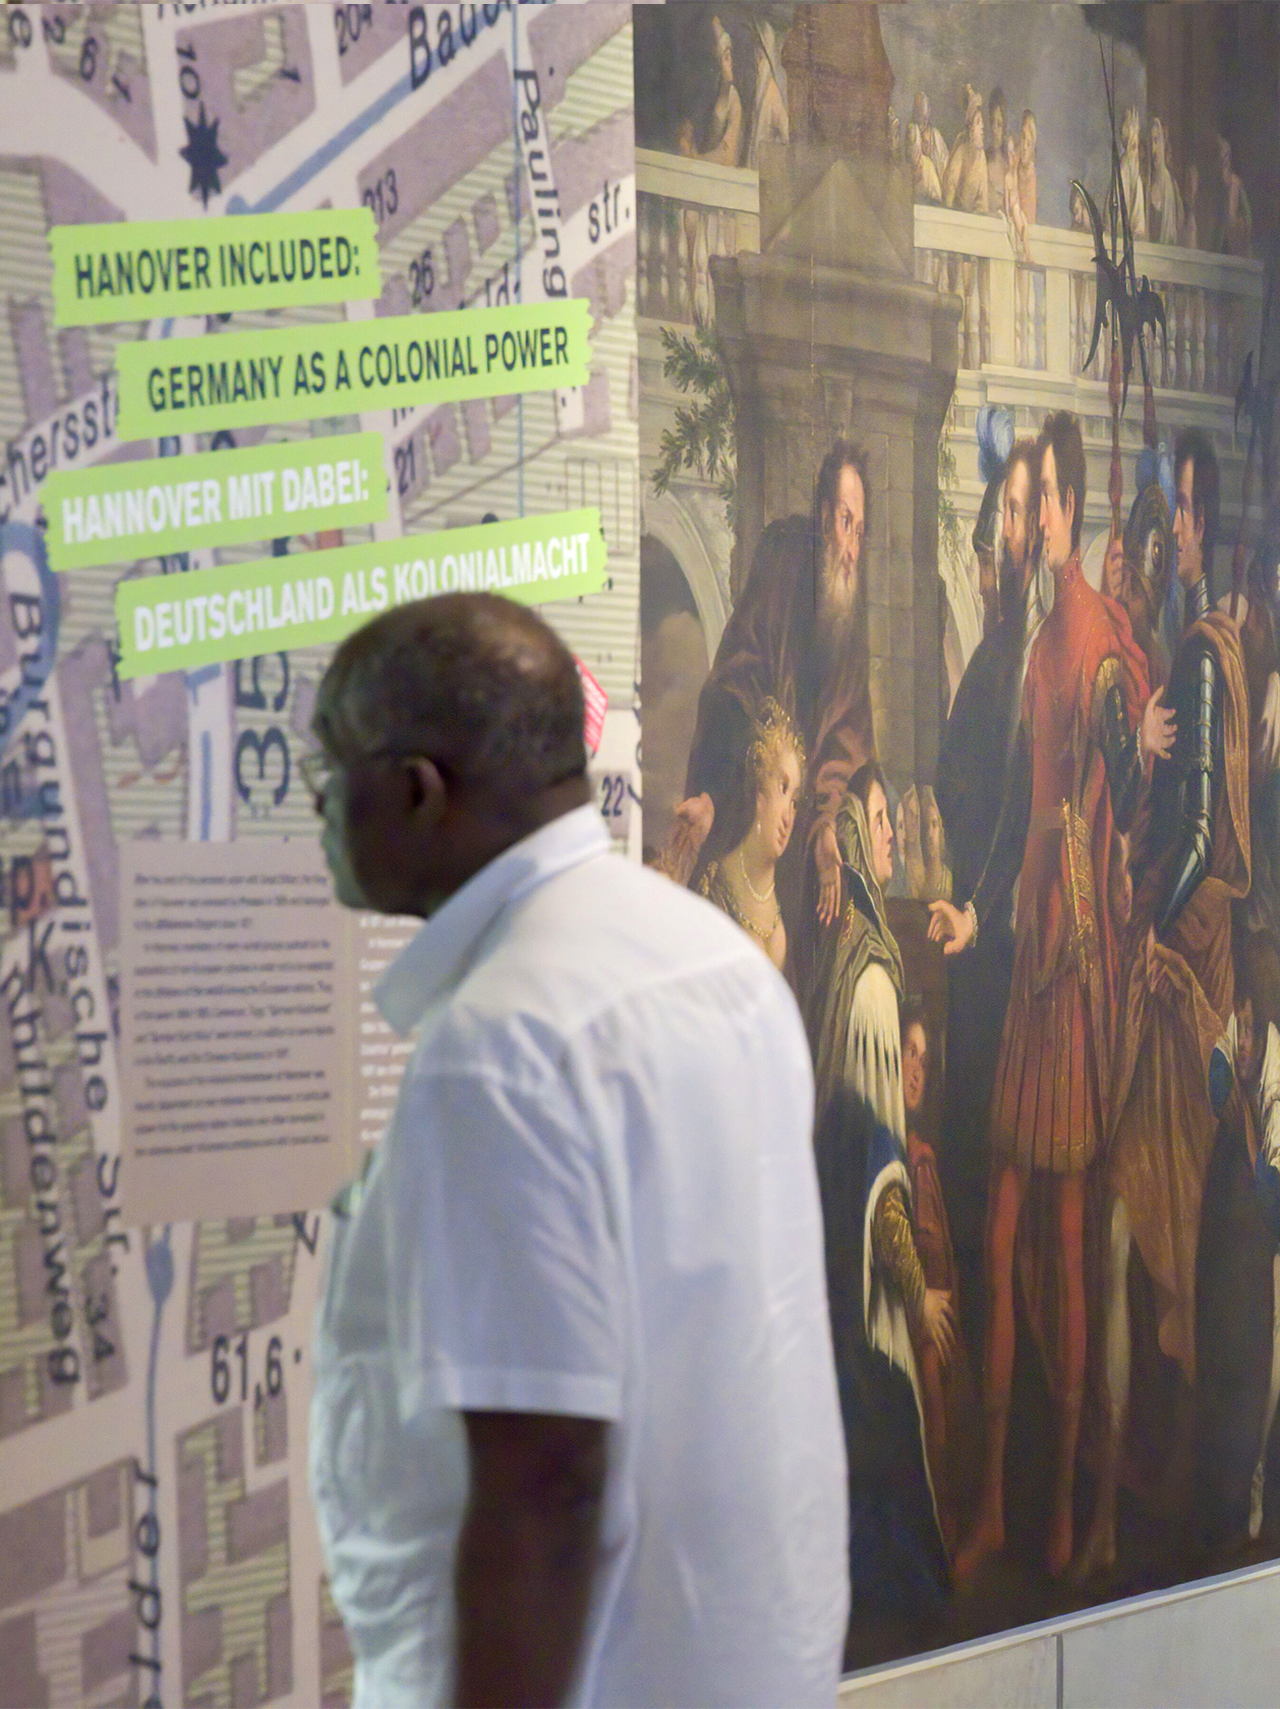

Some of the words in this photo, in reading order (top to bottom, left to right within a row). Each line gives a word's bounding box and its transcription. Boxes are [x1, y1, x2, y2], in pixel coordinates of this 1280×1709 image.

[74, 245, 210, 300] HANOVER
[219, 236, 361, 289] INCLUDED:
[147, 355, 284, 413] GERMANY
[293, 351, 327, 397] AS
[335, 349, 353, 392] A
[358, 335, 480, 390] COLONIAL
[486, 325, 570, 374] POWER
[62, 480, 222, 545] HANNOVER
[227, 472, 276, 521] MIT
[281, 459, 370, 514] DABEI:
[133, 578, 336, 652] DEUTSCHLAND
[340, 566, 388, 617] ALS
[393, 533, 590, 604] KOLONIALMACHT
